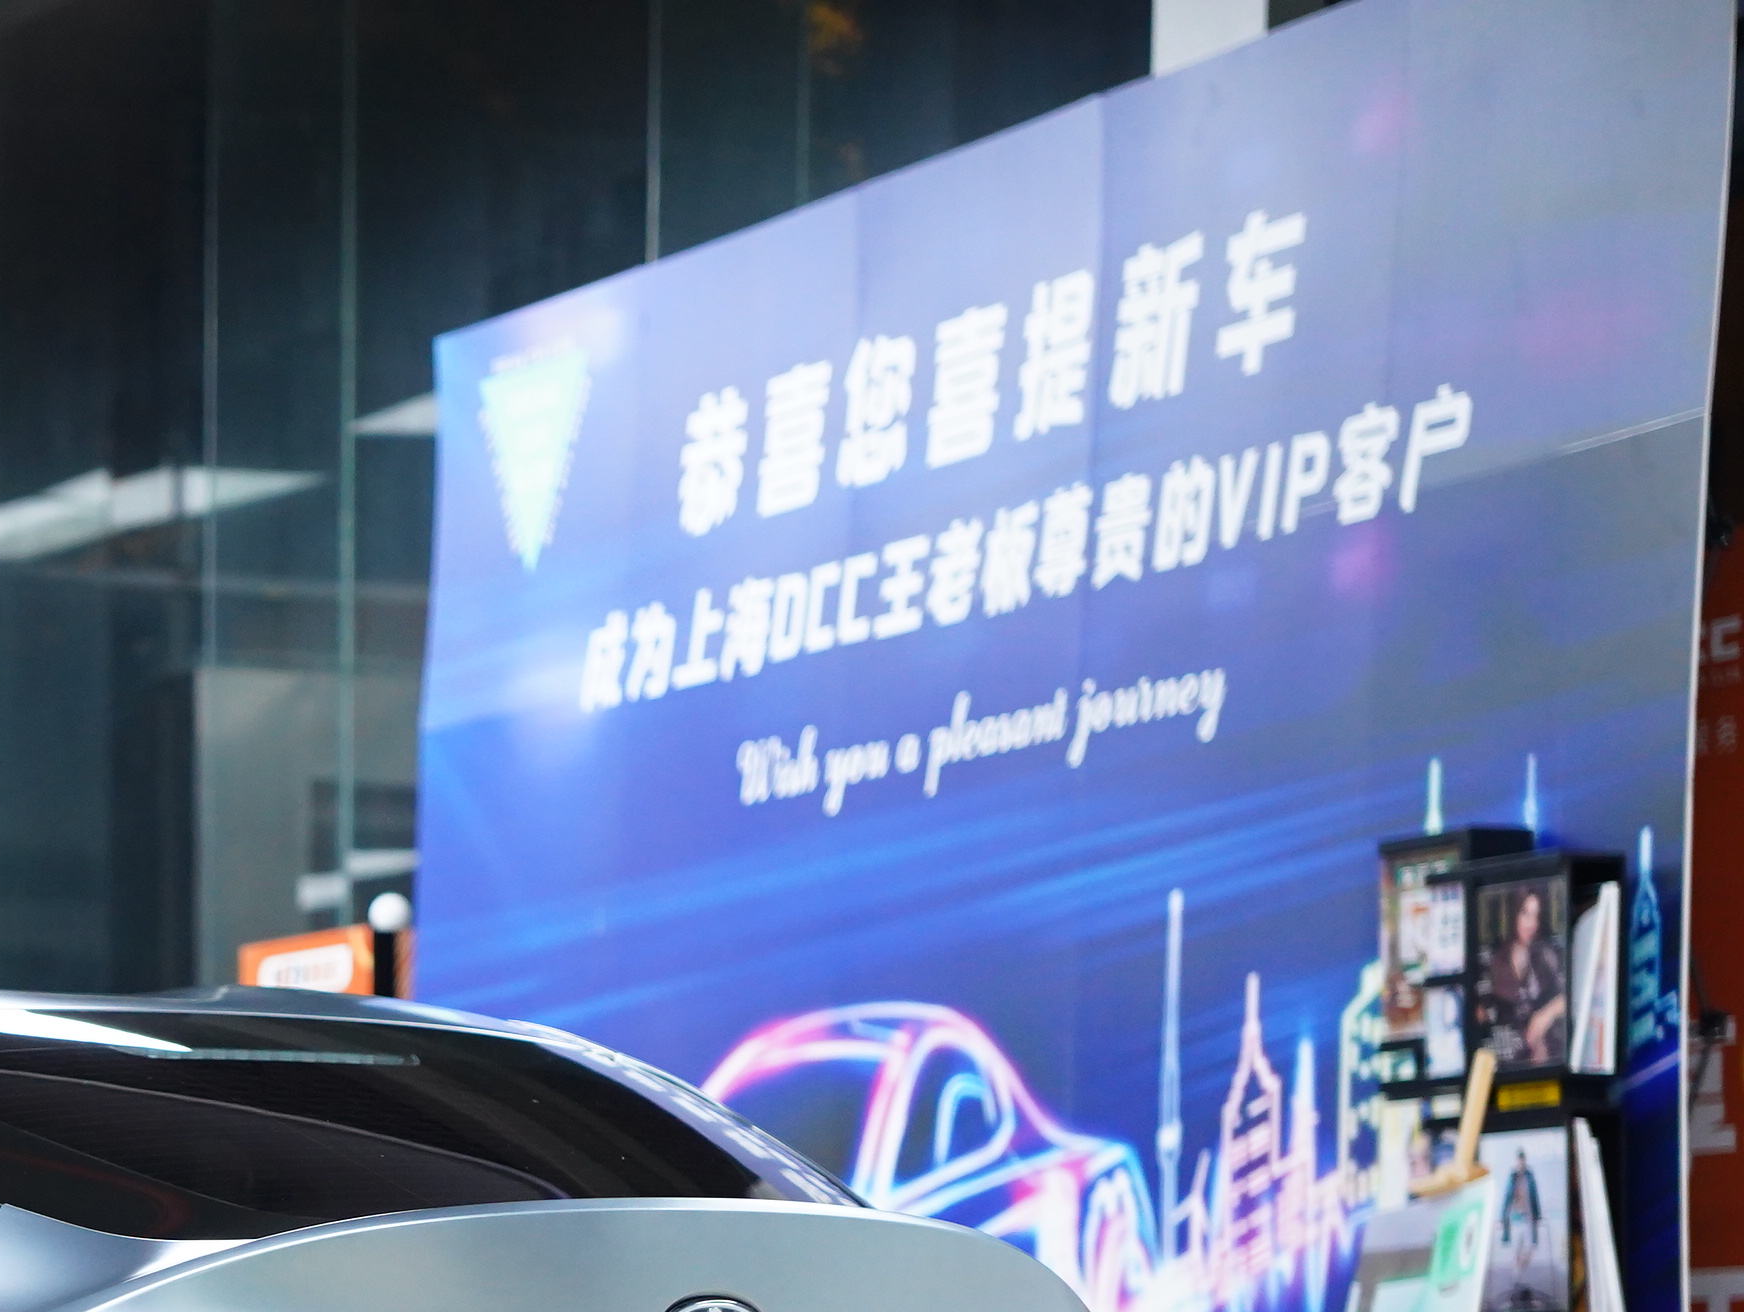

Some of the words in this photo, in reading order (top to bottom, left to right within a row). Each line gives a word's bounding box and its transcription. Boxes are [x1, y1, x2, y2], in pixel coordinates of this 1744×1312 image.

[678, 208, 1307, 538] 恭喜您喜提新车
[736, 724, 819, 806] Wish
[822, 740, 890, 818] you
[895, 733, 922, 774] a
[923, 690, 1069, 798] pleasant
[1066, 667, 1226, 768] journey
